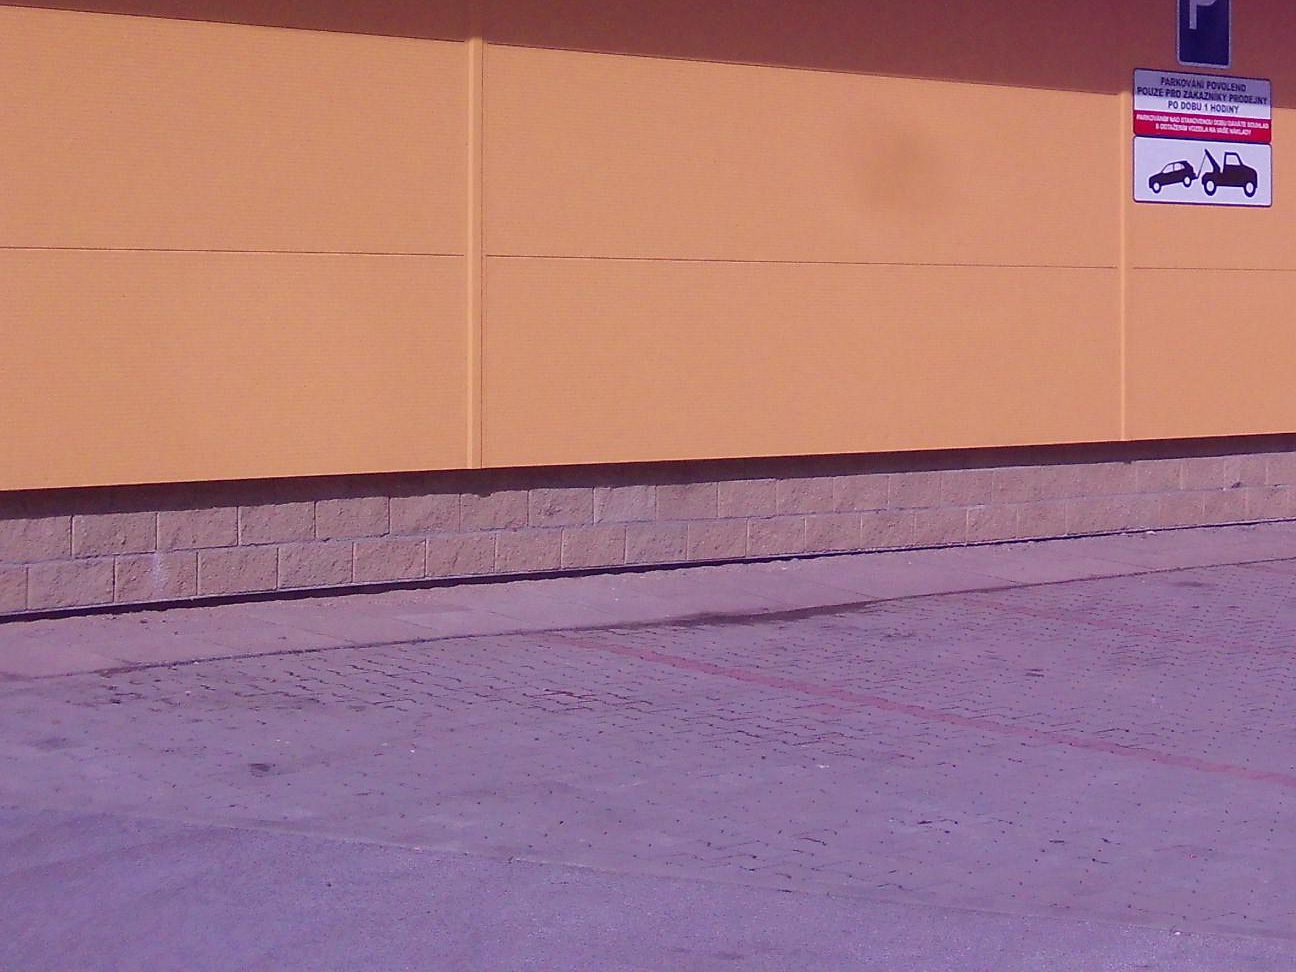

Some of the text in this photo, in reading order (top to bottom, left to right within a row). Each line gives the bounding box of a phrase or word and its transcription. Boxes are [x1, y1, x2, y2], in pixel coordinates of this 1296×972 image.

[1137, 86, 1164, 97] POUZE
[1165, 89, 1181, 99] PRO
[1206, 81, 1247, 93] POVOLENO
[1168, 100, 1179, 110] PO
[1180, 101, 1202, 111] DOBU
[1210, 104, 1240, 114] HODINY
